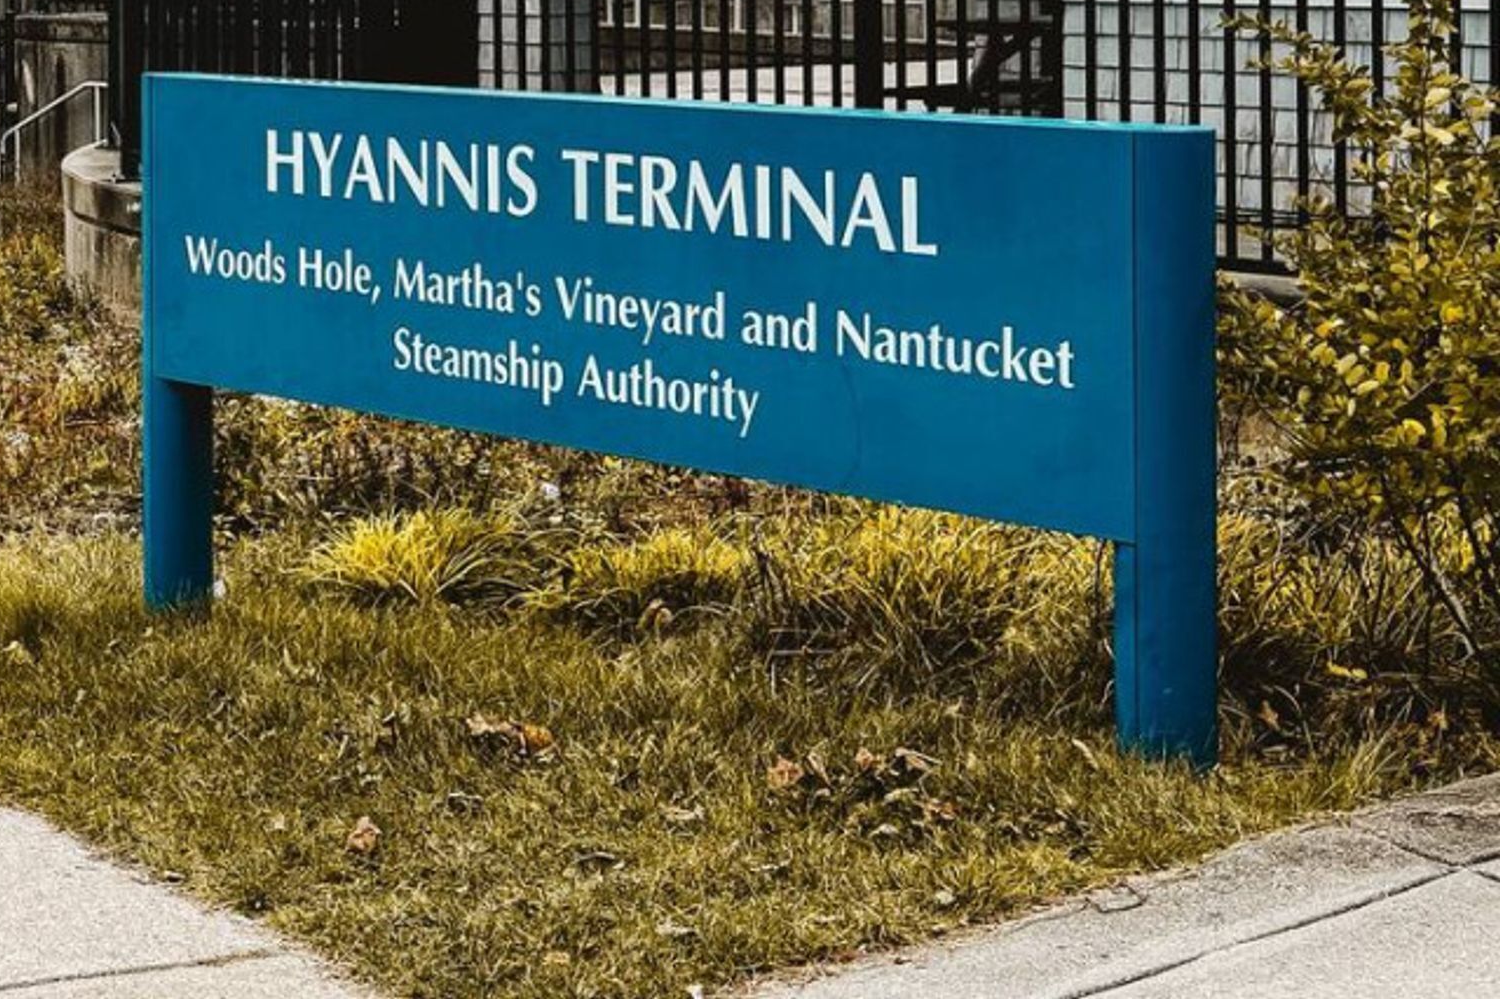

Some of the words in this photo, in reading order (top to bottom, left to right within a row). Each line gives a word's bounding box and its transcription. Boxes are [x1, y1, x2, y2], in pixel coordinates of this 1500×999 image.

[266, 128, 538, 217] HYANNIS
[562, 149, 938, 257] TERMINAL
[185, 235, 286, 284] Woods
[299, 247, 382, 303] Hole,
[394, 259, 541, 317] Martha's
[555, 277, 725, 346] Vineyard
[742, 302, 817, 353] and
[837, 310, 1075, 389] Nantucket
[394, 327, 564, 406] Steamship
[578, 355, 759, 438] Authority
